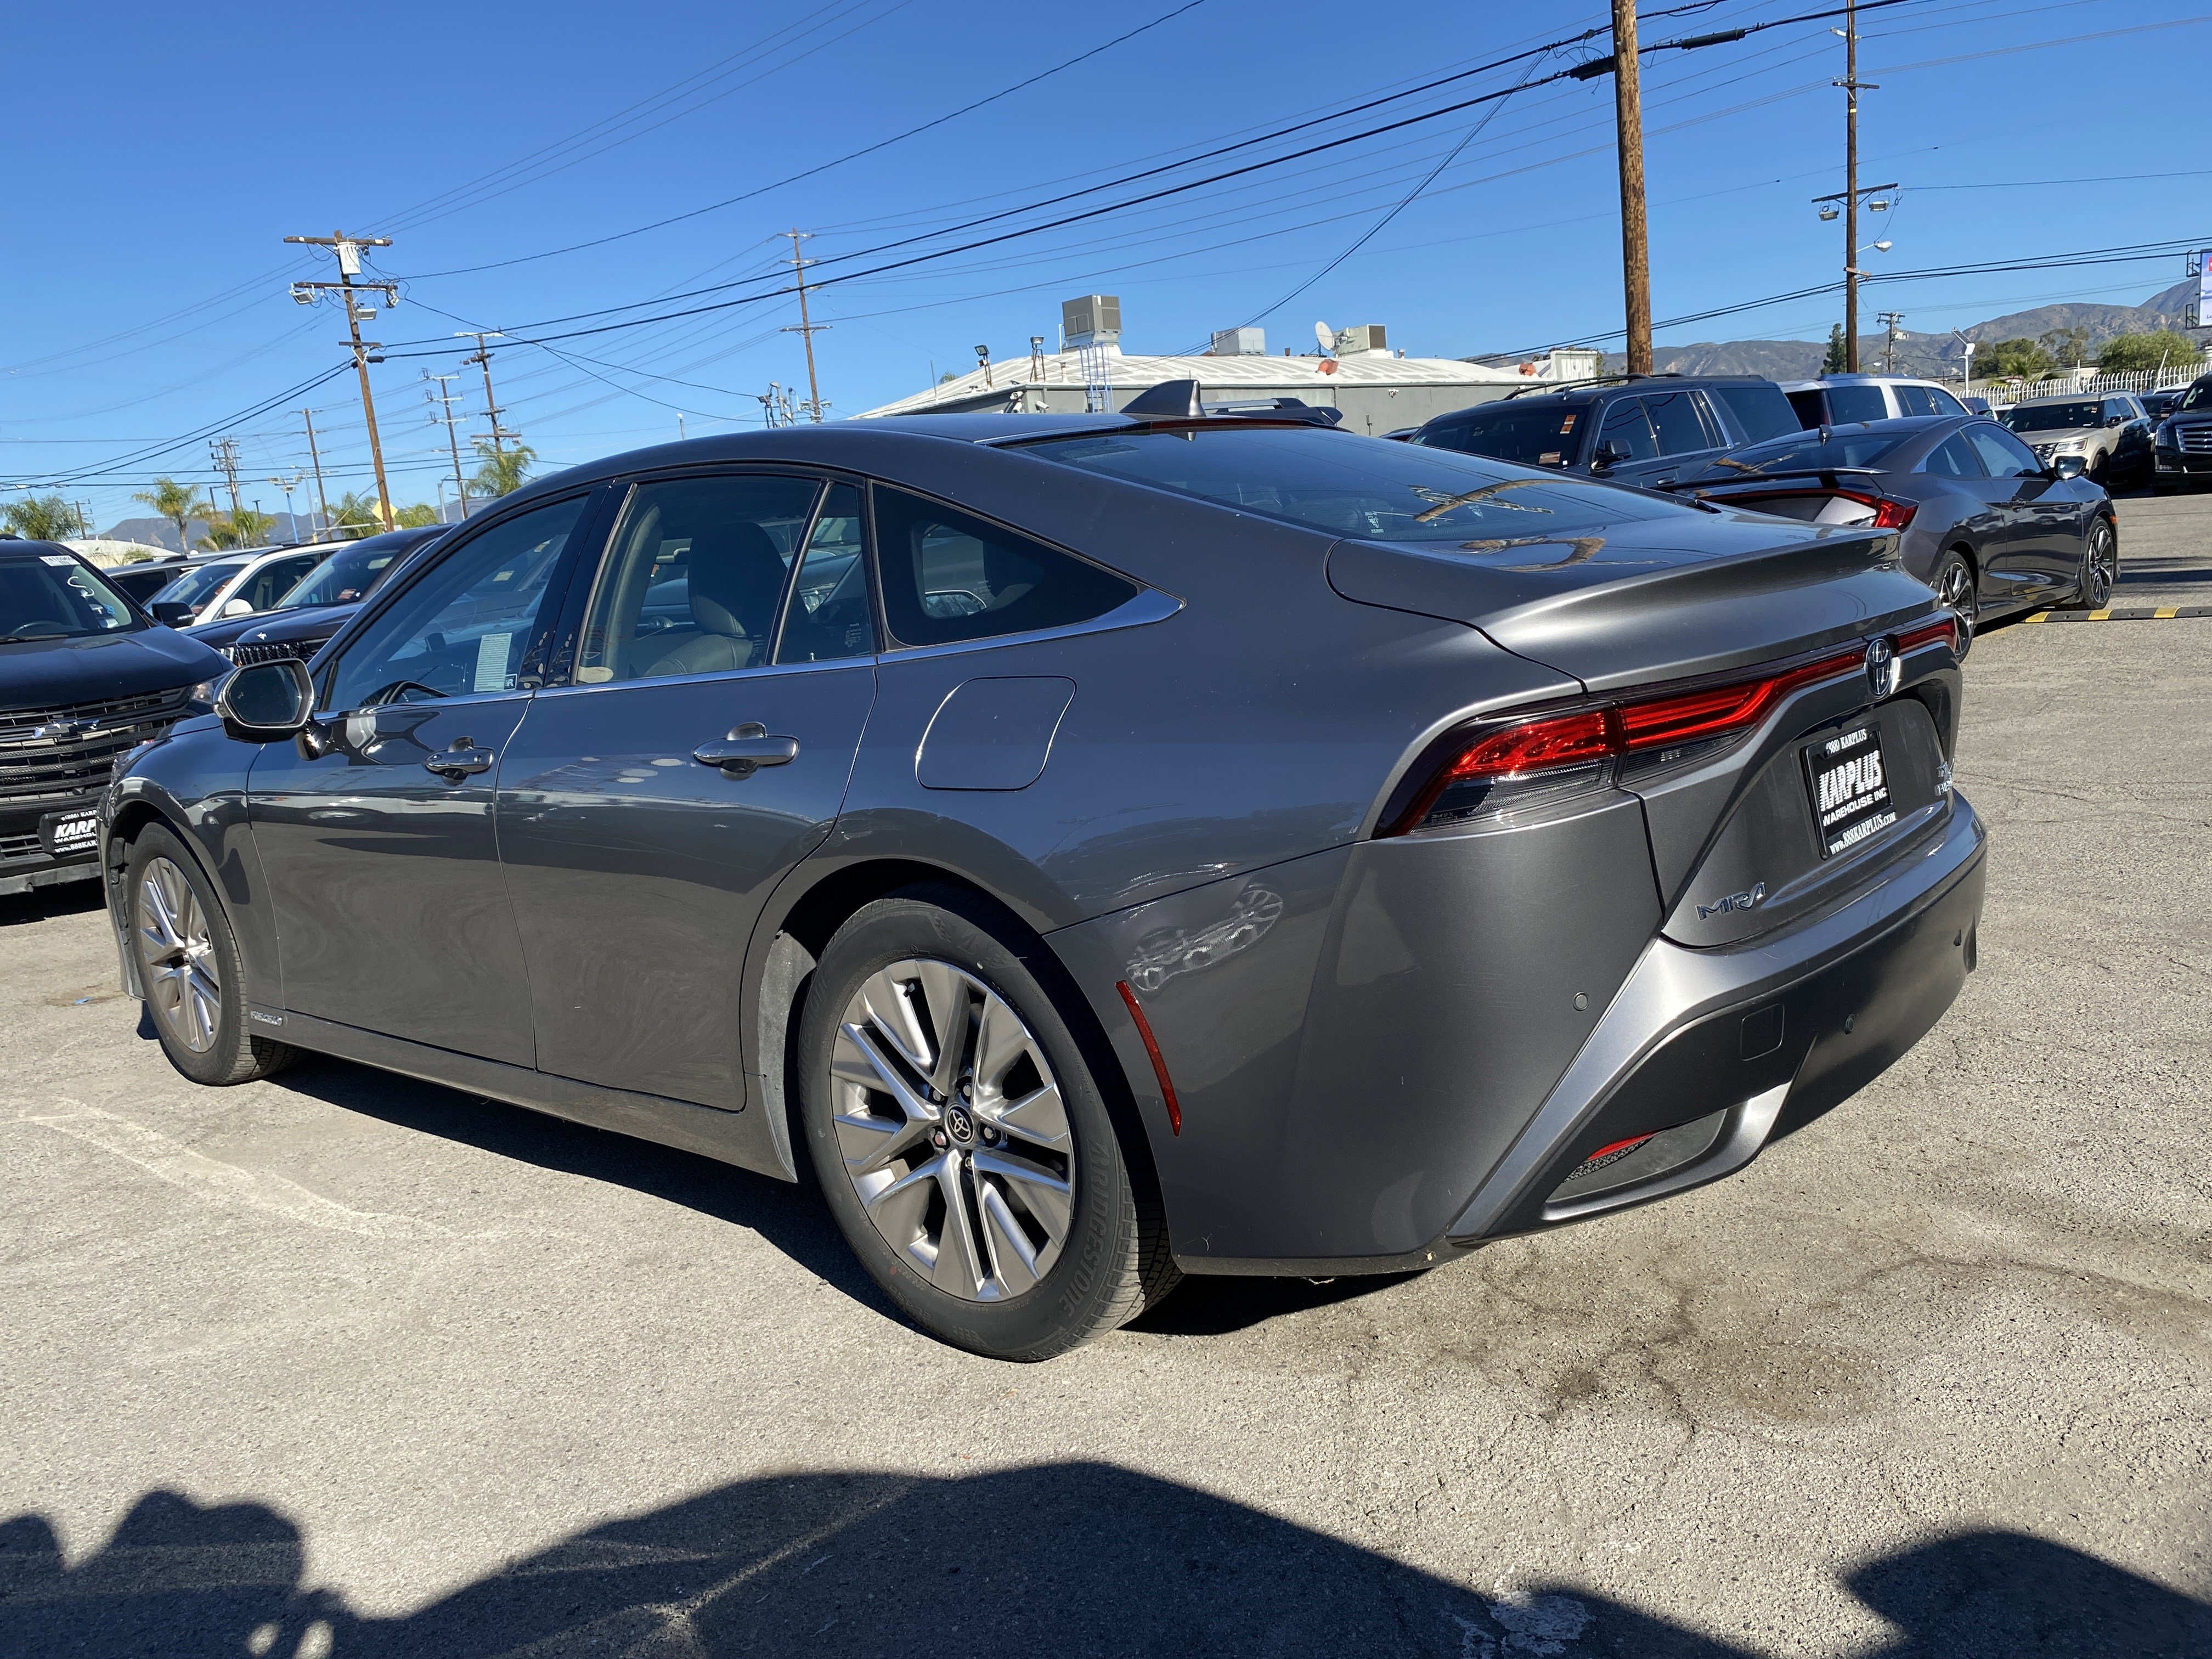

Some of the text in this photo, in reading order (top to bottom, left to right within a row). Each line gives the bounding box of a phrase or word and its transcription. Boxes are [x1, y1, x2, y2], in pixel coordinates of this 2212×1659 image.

[1839, 727, 1867, 749] KARPLUS
[1819, 749, 1882, 812] KARPLUS
[1822, 793, 1874, 827] WAREHOUSE
[1059, 1137, 1110, 1317] BRIDGESTONE
